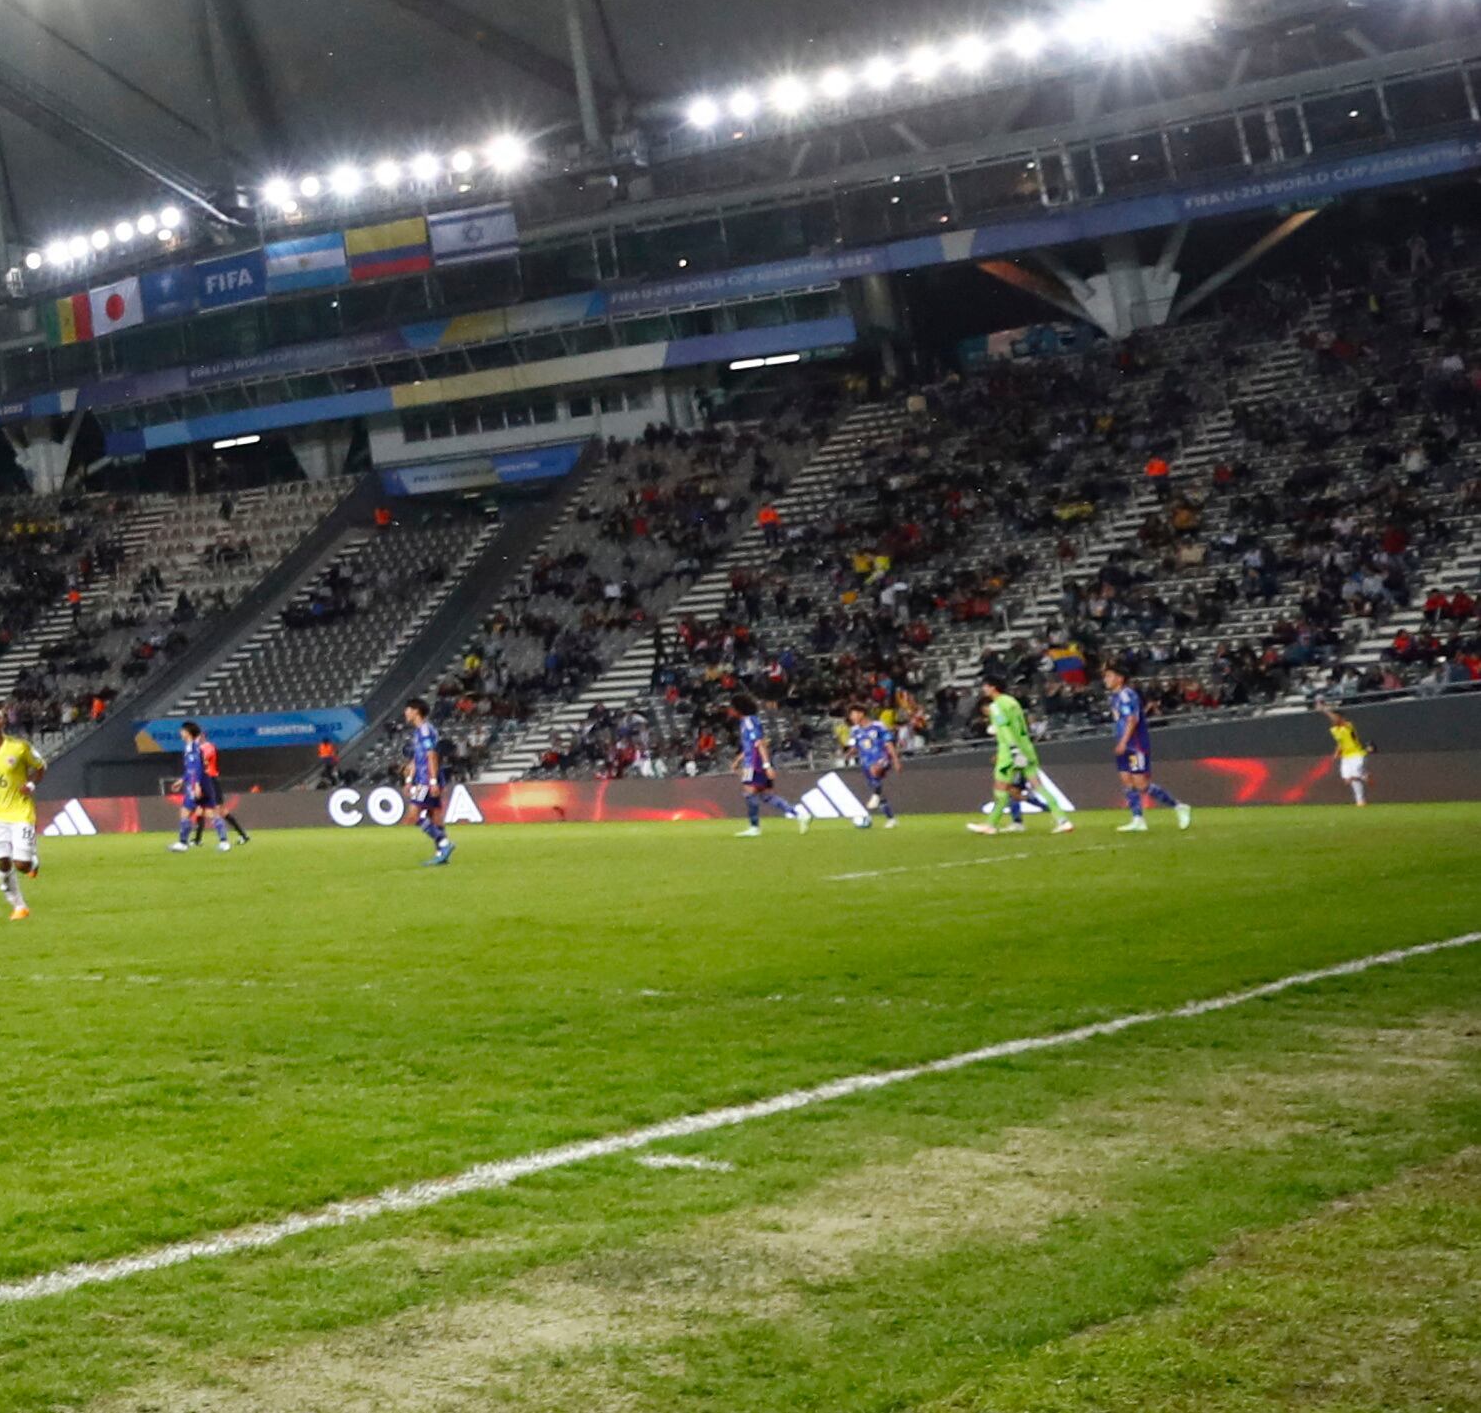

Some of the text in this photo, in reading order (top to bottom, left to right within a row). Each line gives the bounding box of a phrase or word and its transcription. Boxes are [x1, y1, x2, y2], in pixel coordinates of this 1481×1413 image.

[1224, 185, 1262, 202] U-20
[1264, 172, 1330, 194] WORLD
[1332, 165, 1367, 181] CUP
[205, 267, 254, 295] FIFA
[674, 278, 725, 293] WORLD
[328, 783, 484, 827] COA
